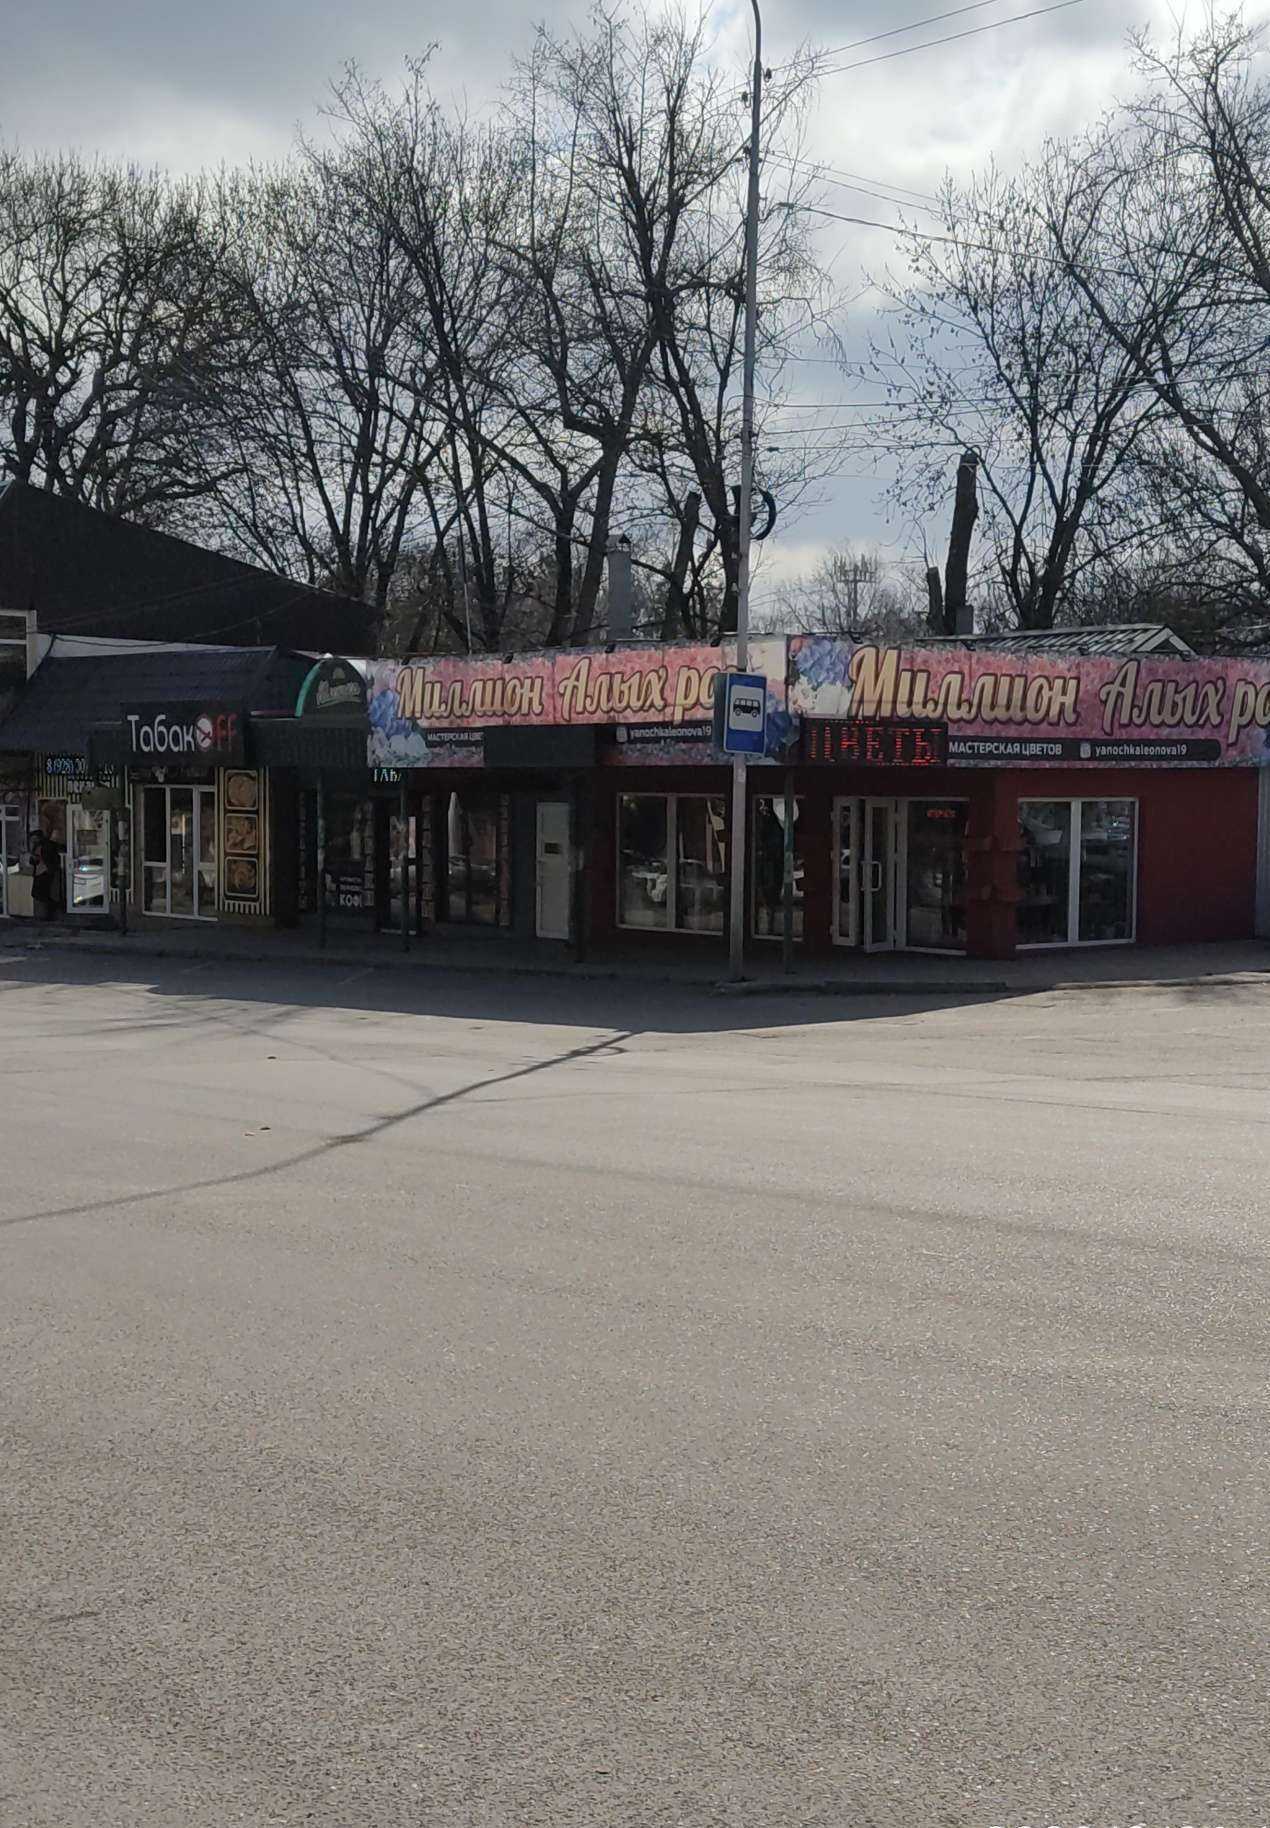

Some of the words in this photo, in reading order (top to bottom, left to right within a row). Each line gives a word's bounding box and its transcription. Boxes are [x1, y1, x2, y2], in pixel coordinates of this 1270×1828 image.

[396, 666, 545, 720] Миллион
[558, 656, 668, 722] Алых
[673, 664, 738, 726] ро
[847, 645, 1080, 725] Миллион
[1098, 657, 1226, 736] Алых
[948, 741, 1021, 754] МАСТЕРСКАЯ
[1022, 743, 1063, 756] ЦВЕТОВ
[1095, 744, 1188, 757] yanochkaleonova19
